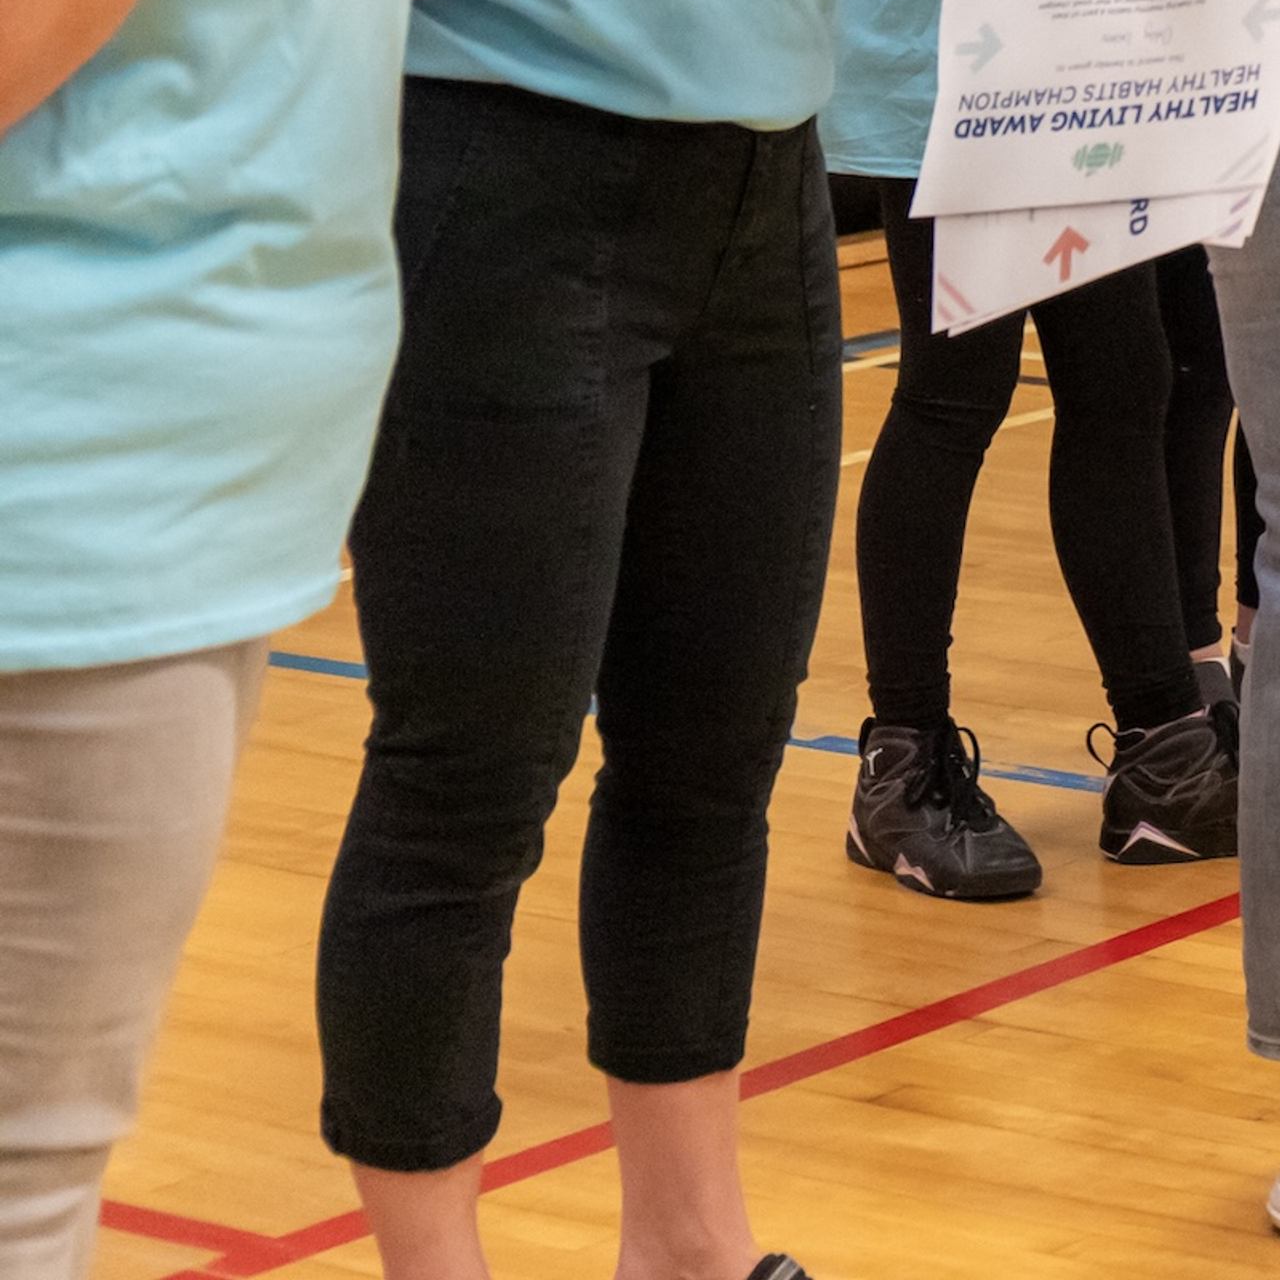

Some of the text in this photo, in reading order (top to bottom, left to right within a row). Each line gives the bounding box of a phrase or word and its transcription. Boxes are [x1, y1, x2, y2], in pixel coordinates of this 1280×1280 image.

[1082, 77, 1162, 103] HABITS
[1166, 63, 1261, 94] HEALTHY
[958, 86, 1077, 111] CHAMPION
[954, 88, 1259, 139] HEALTHY LIVING AWARD
